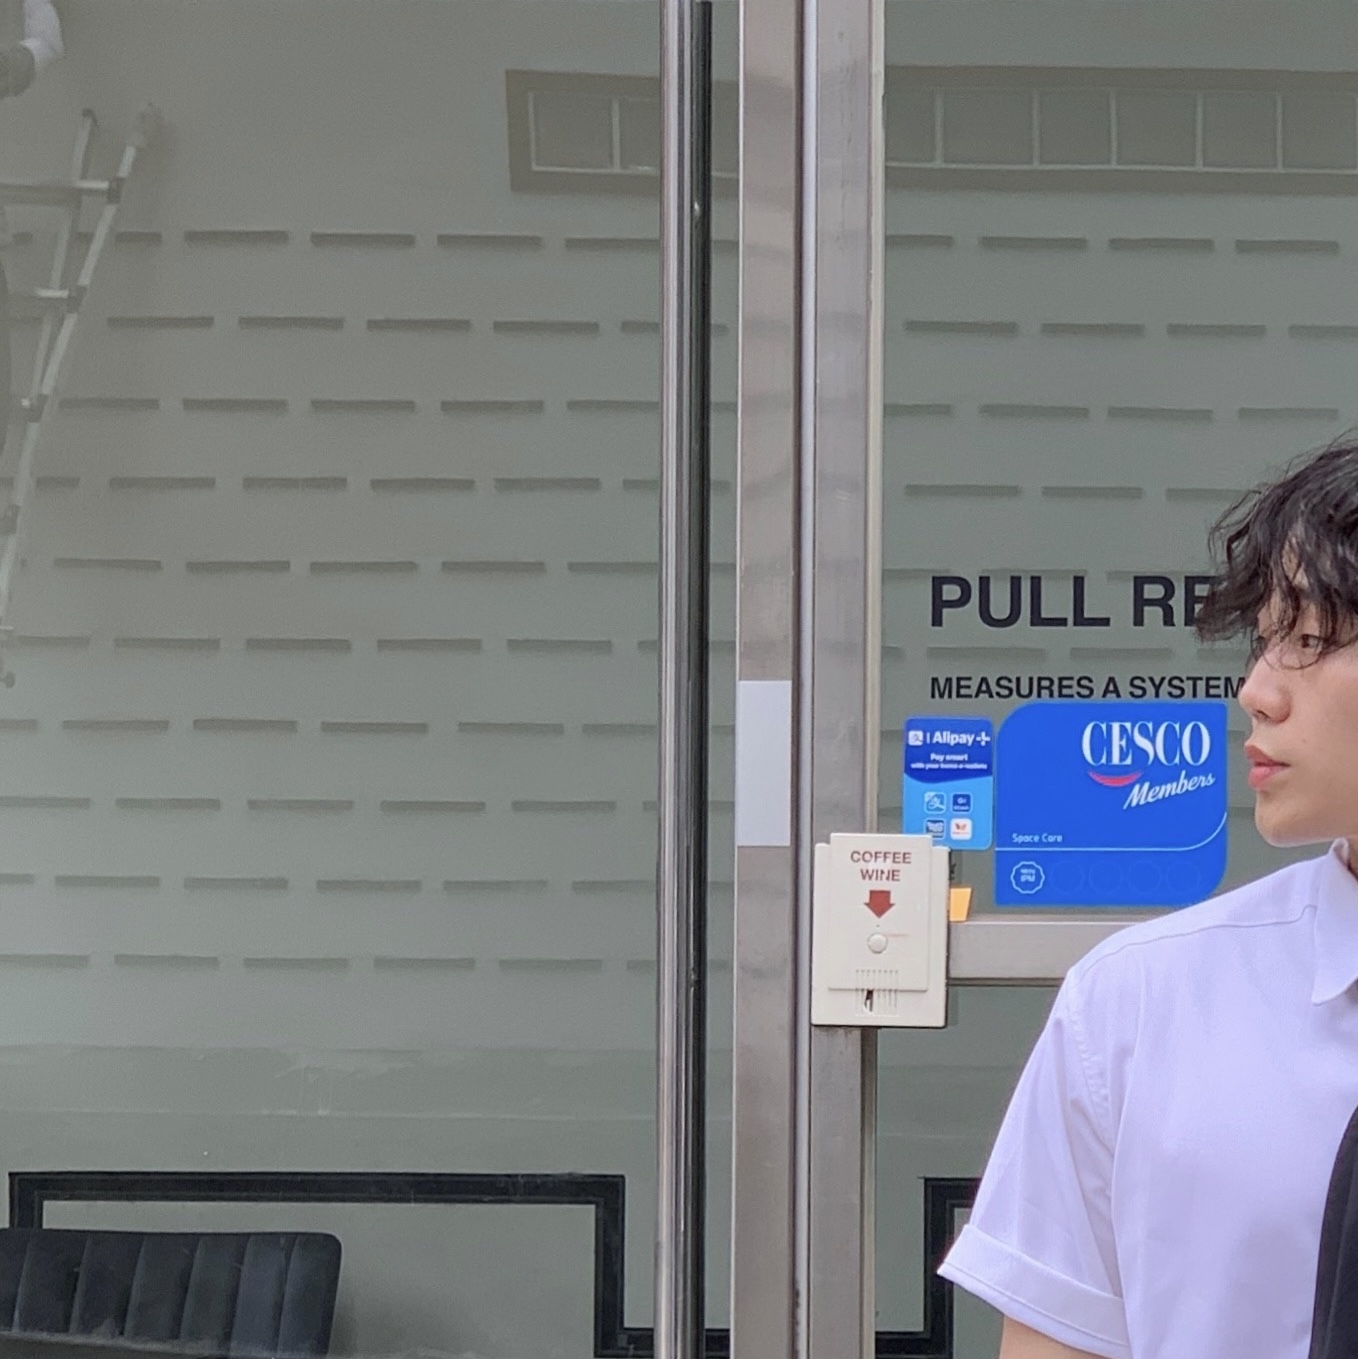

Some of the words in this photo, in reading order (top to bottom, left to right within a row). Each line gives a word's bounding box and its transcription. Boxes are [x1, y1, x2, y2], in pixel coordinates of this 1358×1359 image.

[931, 575, 1111, 628] PULL
[930, 676, 1095, 699] MEASURES
[1101, 676, 1121, 698] A
[1082, 720, 1211, 766] CESCO
[1122, 769, 1216, 810] Members
[1012, 833, 1040, 844] Space
[850, 851, 912, 864] COFFEE
[860, 868, 901, 881] WINE
